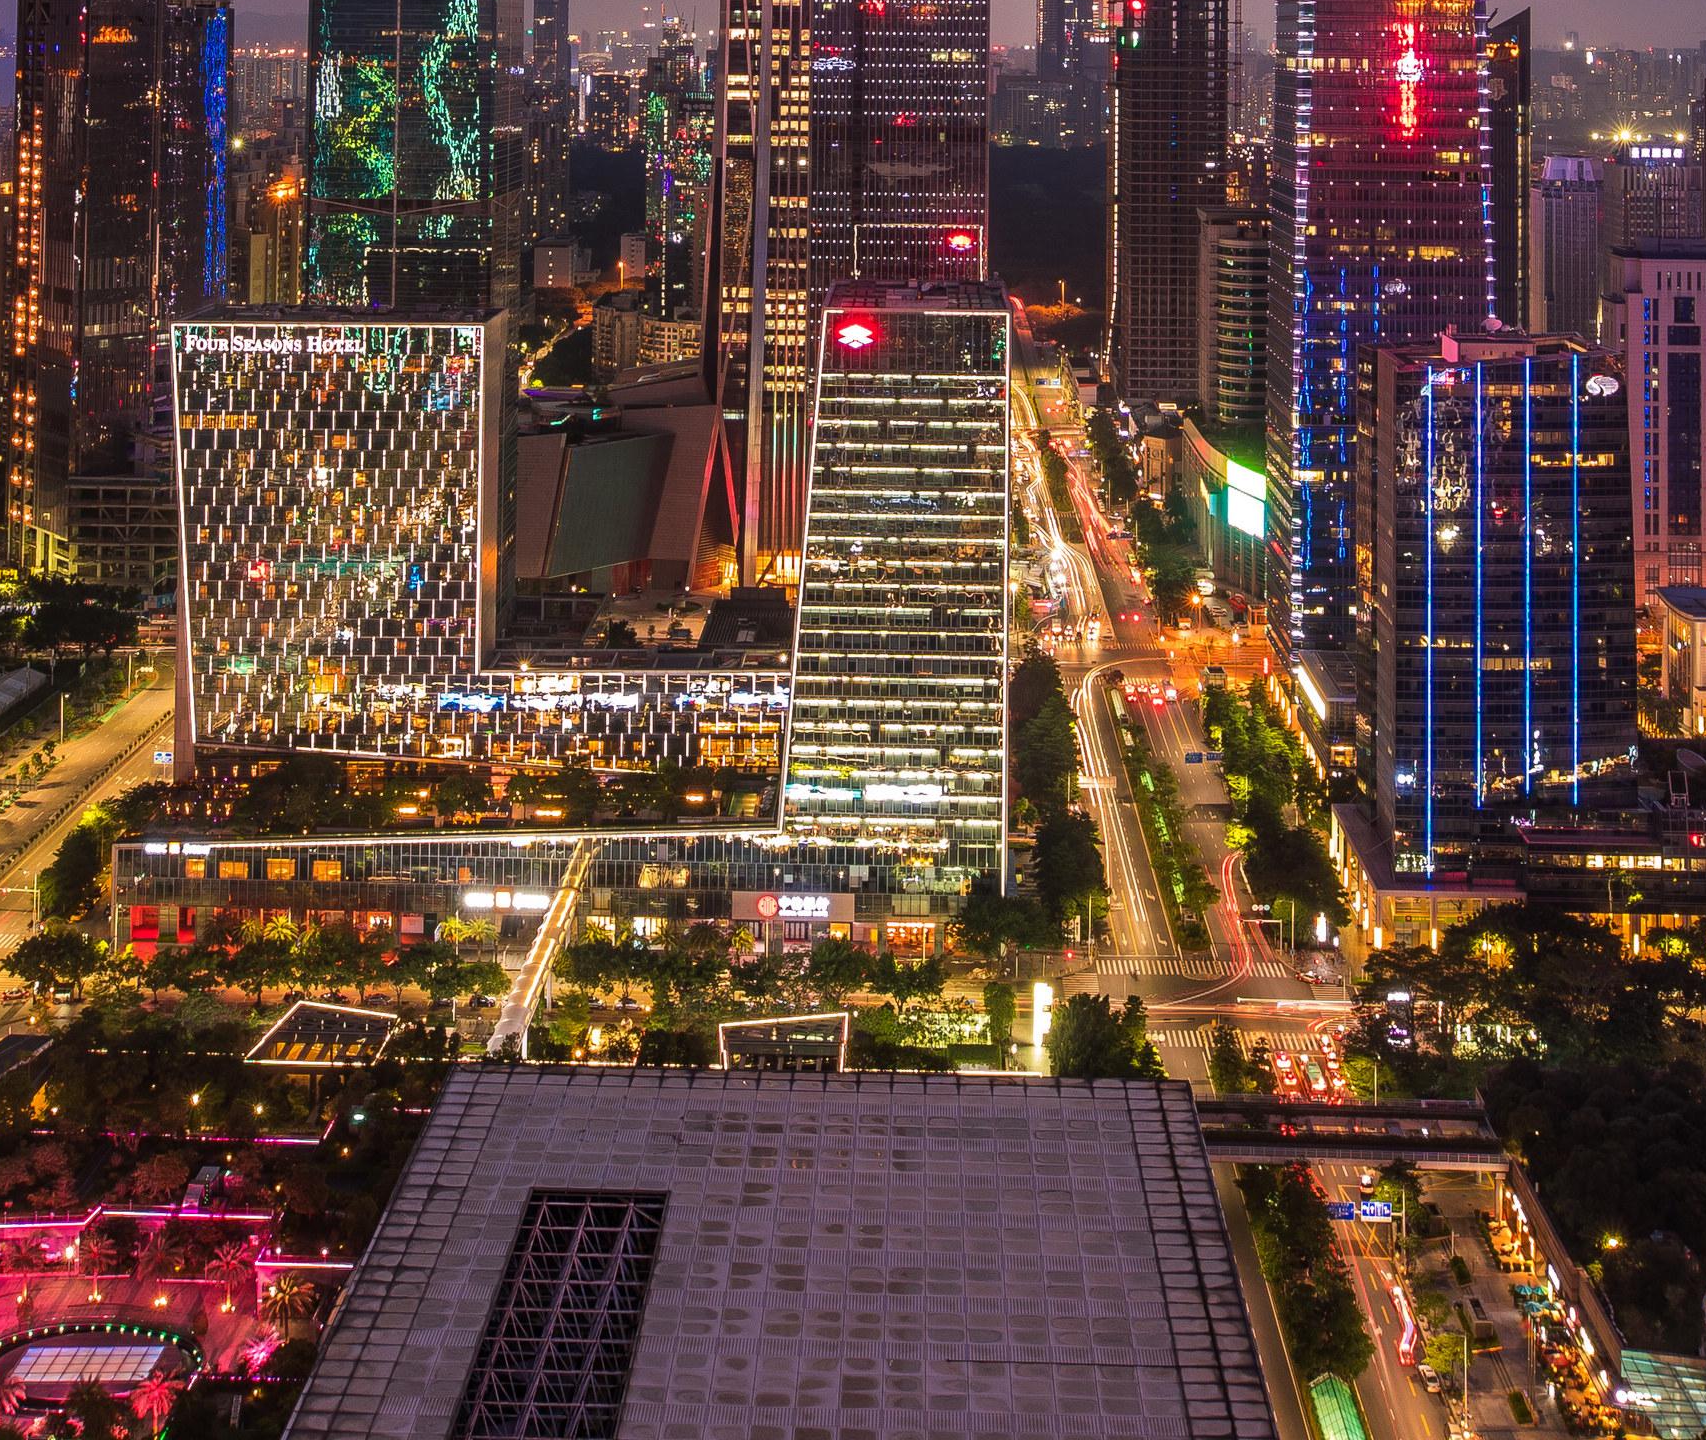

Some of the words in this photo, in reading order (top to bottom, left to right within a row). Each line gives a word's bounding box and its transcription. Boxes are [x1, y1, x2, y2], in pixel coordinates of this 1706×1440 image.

[185, 335, 229, 353] FOUR
[233, 335, 302, 353] SEASONS
[307, 335, 365, 353] HOTEL
